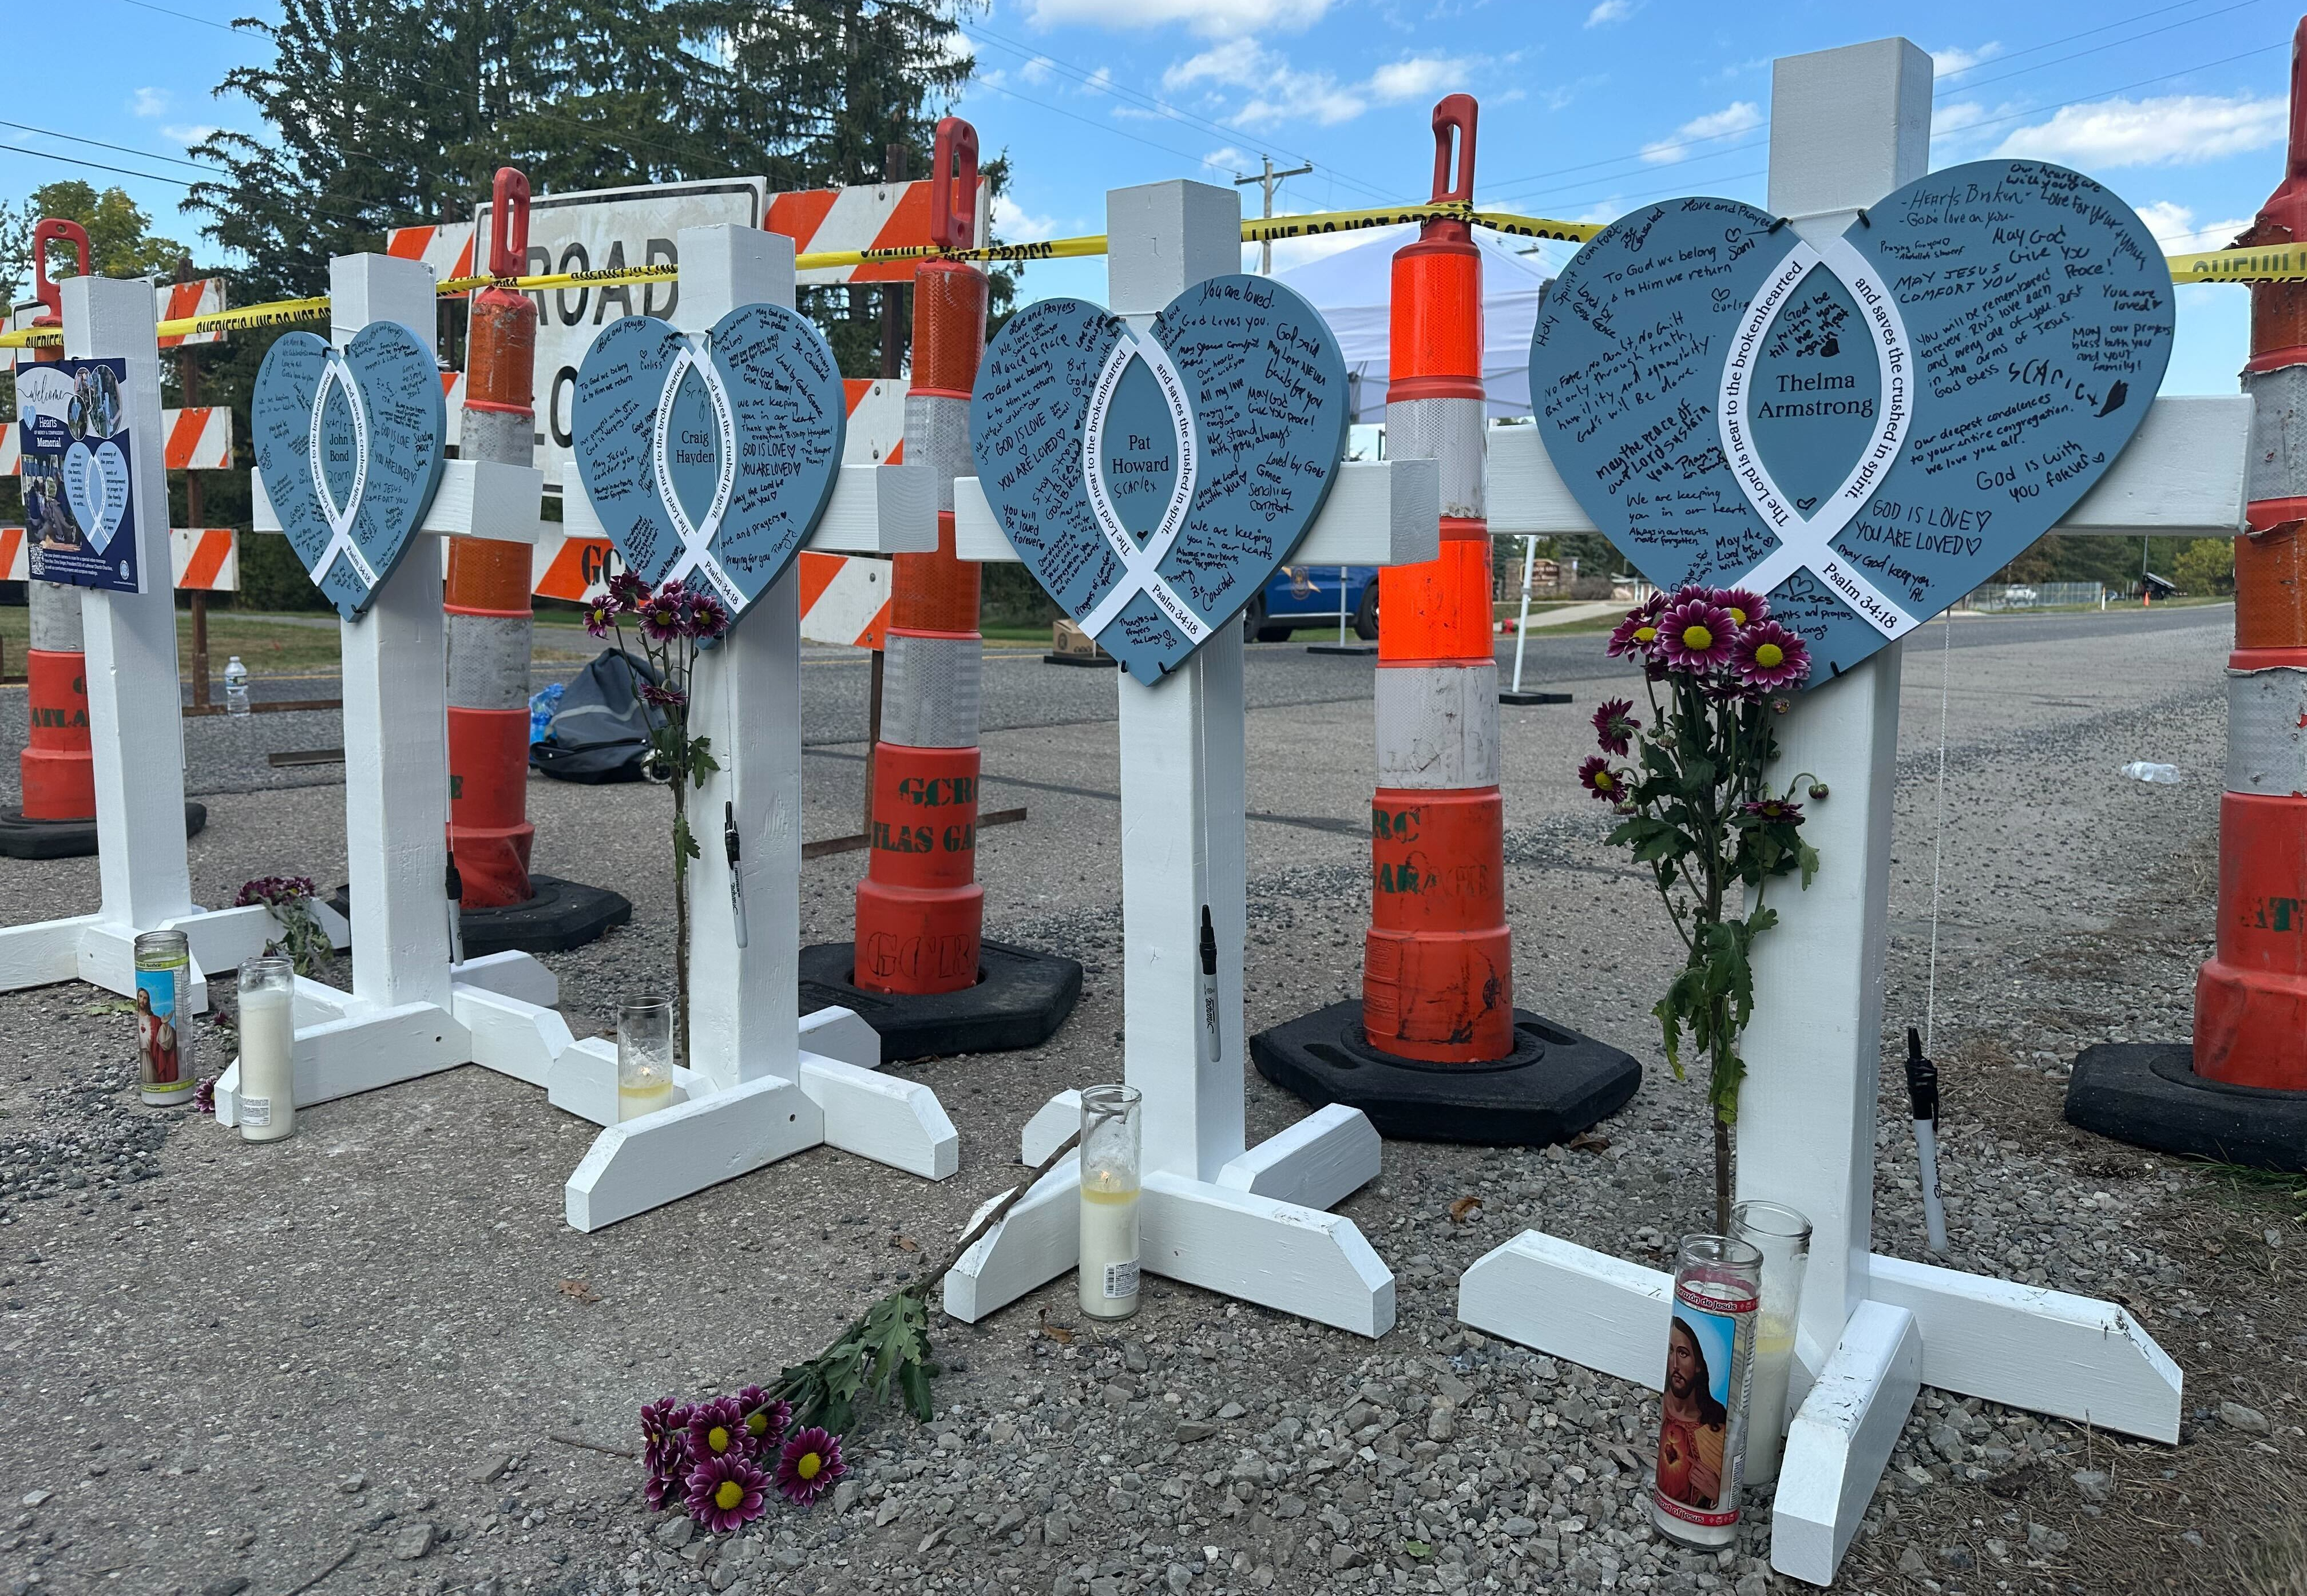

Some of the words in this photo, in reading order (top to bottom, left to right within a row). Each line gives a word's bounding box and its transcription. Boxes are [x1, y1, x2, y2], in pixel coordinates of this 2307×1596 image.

[1992, 228, 2025, 246] May
[2029, 225, 2066, 244] God
[1603, 272, 1623, 283] To
[1627, 258, 1654, 276] God
[1658, 255, 1674, 267] we
[1679, 246, 1717, 263] belong
[2009, 247, 2051, 264] Give
[525, 239, 678, 326] ROAD
[1624, 287, 1635, 297] to
[1639, 279, 1664, 293] Him
[1666, 273, 1683, 285] we
[1688, 263, 1732, 281] return
[1893, 271, 1936, 291] MAY
[1944, 263, 2001, 280] JESUS
[1899, 283, 1975, 304] COMFORT
[1983, 273, 2017, 290] YOU
[1225, 287, 1240, 300] are
[1855, 278, 1881, 305] and
[2103, 284, 2129, 297] You
[1732, 261, 1803, 368] brokenhearted
[1873, 305, 1896, 345] saves
[1889, 347, 1904, 374] the
[1156, 364, 1170, 384] and
[1729, 372, 1742, 396] the
[1776, 372, 1855, 392] Thelma
[312, 371, 331, 431] brokenhearted
[346, 383, 354, 397] and
[659, 361, 685, 430] brokenhearted
[1089, 350, 1126, 432] brokenhearted
[1168, 385, 1183, 416] saves
[351, 398, 359, 421] saves
[1726, 400, 1737, 416] to
[1758, 399, 1873, 418] Armstrong
[1884, 376, 1905, 442] crushed
[39, 417, 57, 427] Hearts
[706, 374, 717, 391] and
[715, 393, 726, 418] saves
[724, 439, 733, 482] crushed
[996, 436, 1013, 455] GOD
[1015, 427, 1024, 443] IS
[1023, 411, 1046, 436] LOVE
[1180, 413, 1188, 438] the
[37, 437, 61, 447] Memorial
[330, 434, 348, 445] John
[681, 430, 708, 447] Craig
[1087, 436, 1095, 452] the
[1129, 435, 1151, 450] Pat
[1726, 420, 1745, 454] near
[312, 450, 316, 458] to
[330, 450, 349, 462] Bond
[657, 451, 663, 461] to
[676, 450, 715, 466] Hayden
[743, 443, 756, 456] GOD
[758, 443, 766, 456] IS
[768, 443, 786, 457] LOVE
[1873, 443, 1890, 460] in
[742, 463, 755, 477] YOU
[756, 463, 770, 477] ARE
[772, 463, 792, 477] LOVED
[998, 473, 1016, 491] YOU
[1015, 455, 1034, 477] ARE
[1032, 437, 1058, 463] LOVED
[1087, 458, 1095, 471] to
[1112, 455, 1169, 475] Howard
[1180, 441, 1192, 492] crushed
[1738, 454, 1750, 471] is
[1089, 472, 1100, 502] near
[1742, 470, 1770, 502] Lord
[1845, 461, 1878, 499] spirit.
[319, 490, 329, 510] Lord
[350, 487, 359, 508] spirit.
[667, 497, 680, 521] Lord
[1098, 501, 1104, 511] is
[1177, 495, 1186, 505] in
[1100, 511, 1119, 535] Lord
[1161, 506, 1180, 534] spirit.
[1767, 496, 1790, 527] The
[1873, 499, 1901, 520] GOD
[1908, 507, 1921, 523] IS
[1928, 507, 1973, 530] LOVE
[677, 519, 689, 536] The
[1856, 521, 1881, 541] YOU
[1882, 526, 1911, 548] ARE
[1916, 533, 1963, 554] LOVED
[347, 545, 359, 567] Psalm
[1117, 534, 1130, 556] The
[705, 561, 722, 586] Psalm
[1822, 562, 1861, 601] Psalm
[1860, 595, 1897, 628] 34:18
[1152, 584, 1175, 613] Psalm
[1175, 610, 1198, 634] 34:18
[899, 777, 979, 808] GCR
[1702, 1298, 1712, 1306] de
[1713, 1302, 1737, 1310] Jesús
[1682, 1511, 1703, 1522] Jesus
